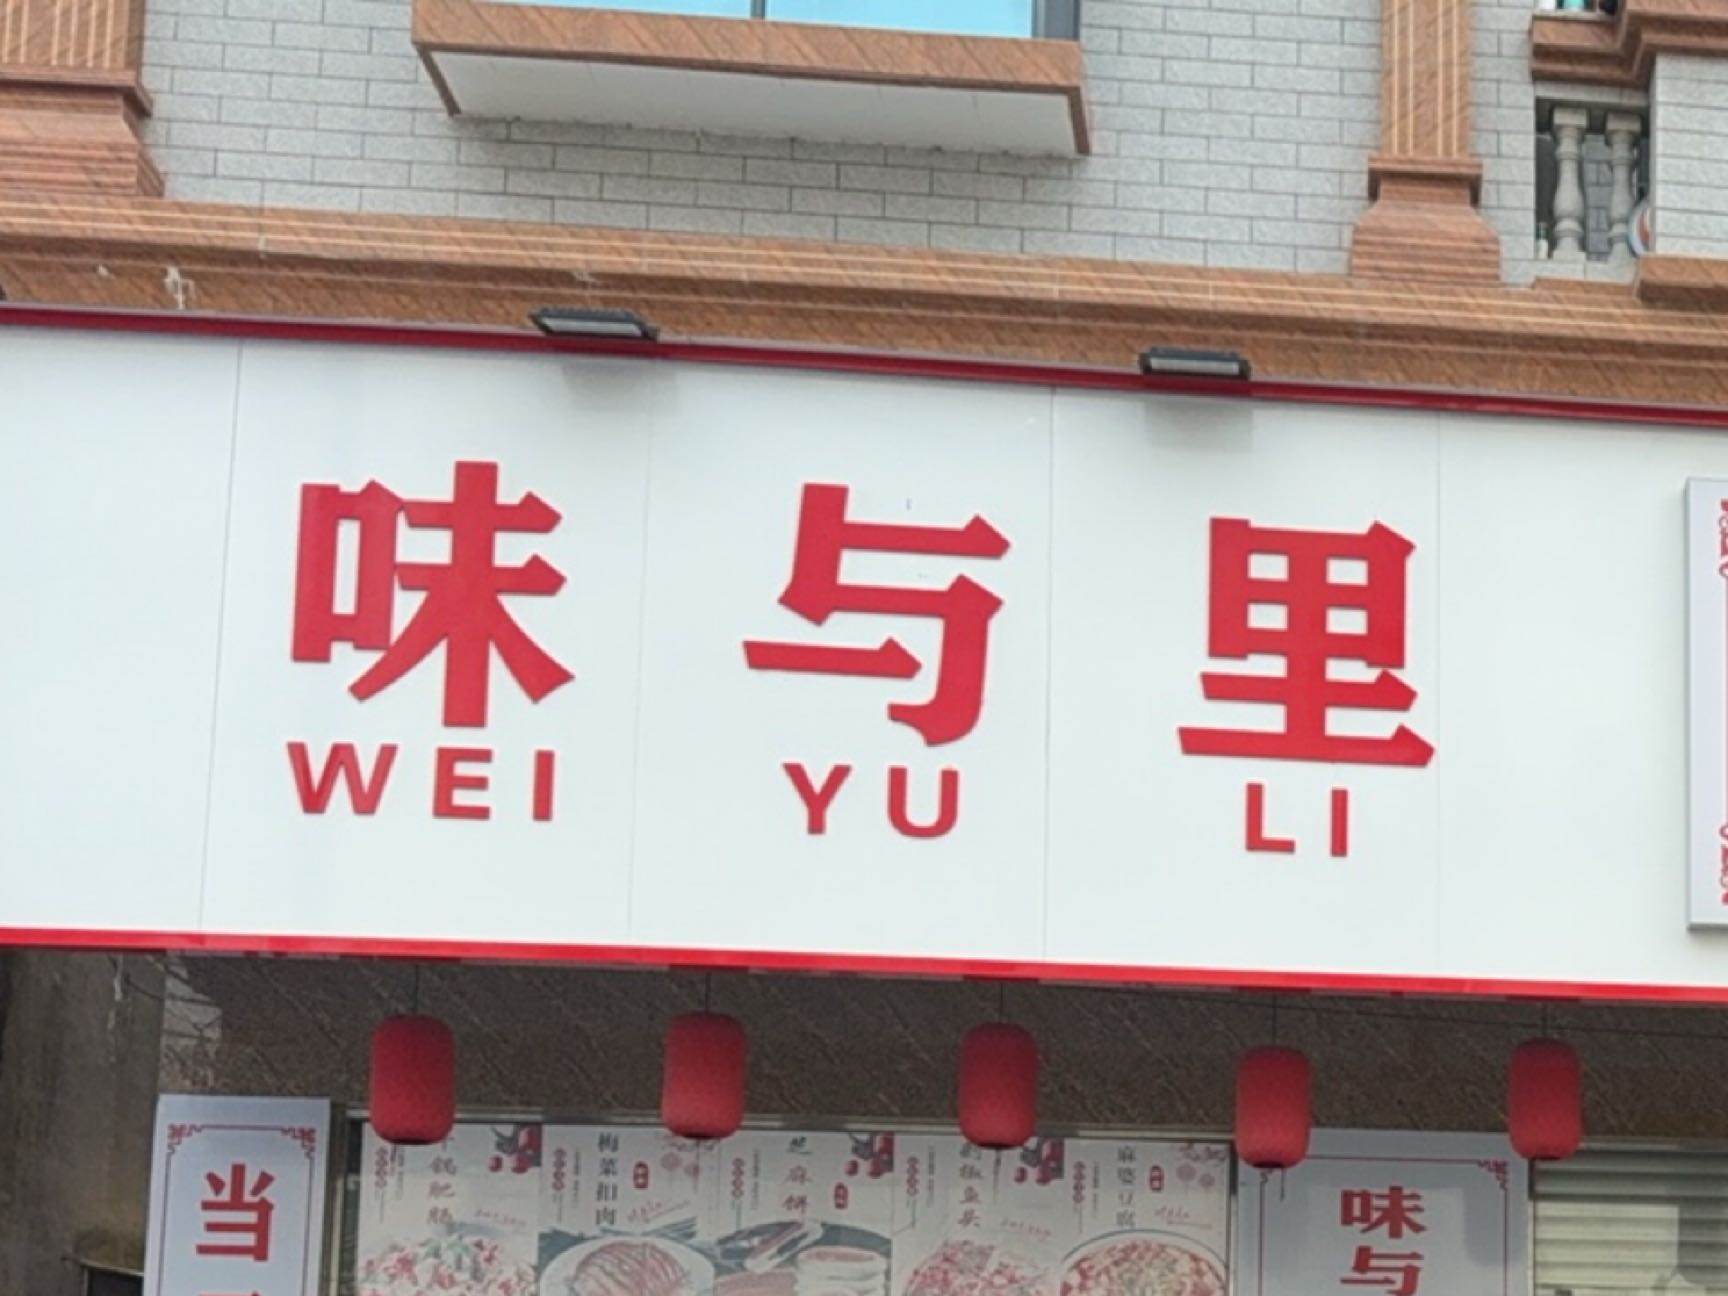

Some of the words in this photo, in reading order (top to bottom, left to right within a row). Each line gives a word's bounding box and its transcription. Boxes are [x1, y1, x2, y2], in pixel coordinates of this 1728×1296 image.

[290, 460, 1436, 768] 味与里
[287, 742, 556, 822] WEI
[783, 762, 961, 839] YU
[1244, 783, 1351, 857] LI
